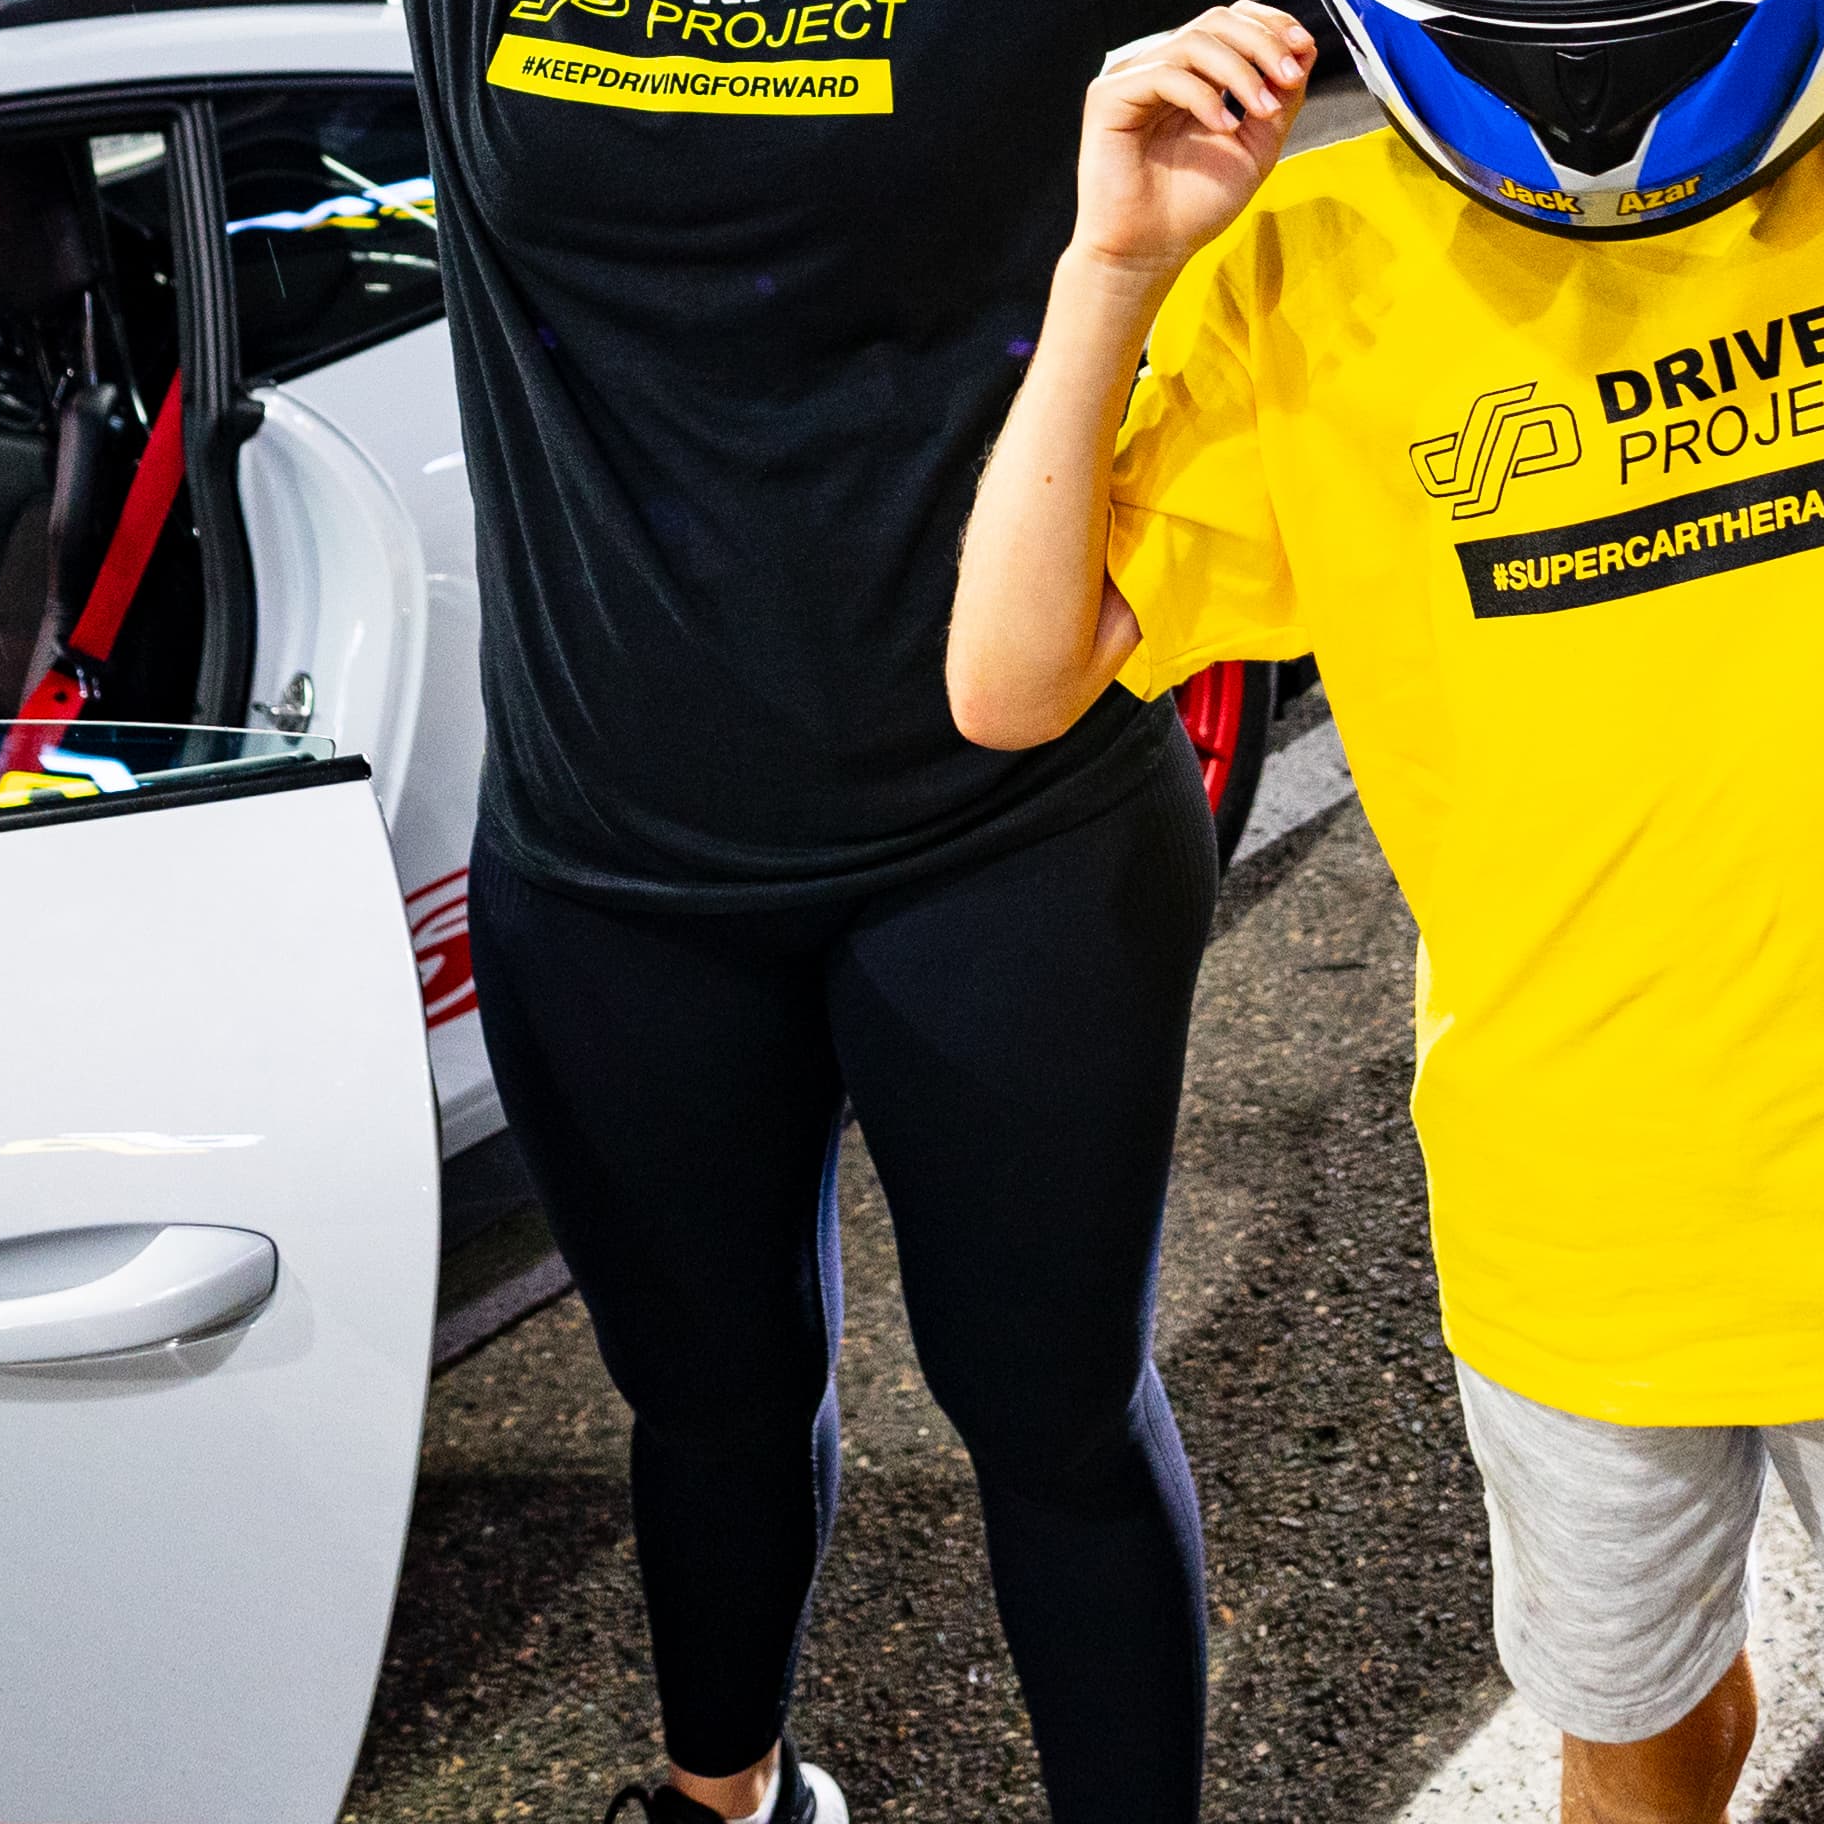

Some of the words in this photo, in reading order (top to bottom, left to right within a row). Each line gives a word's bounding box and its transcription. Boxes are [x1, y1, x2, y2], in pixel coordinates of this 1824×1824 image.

[521, 55, 859, 99] #KEEPDRIVINGFORWARD
[1497, 177, 1582, 214] Jack
[1617, 176, 1701, 216] Azar
